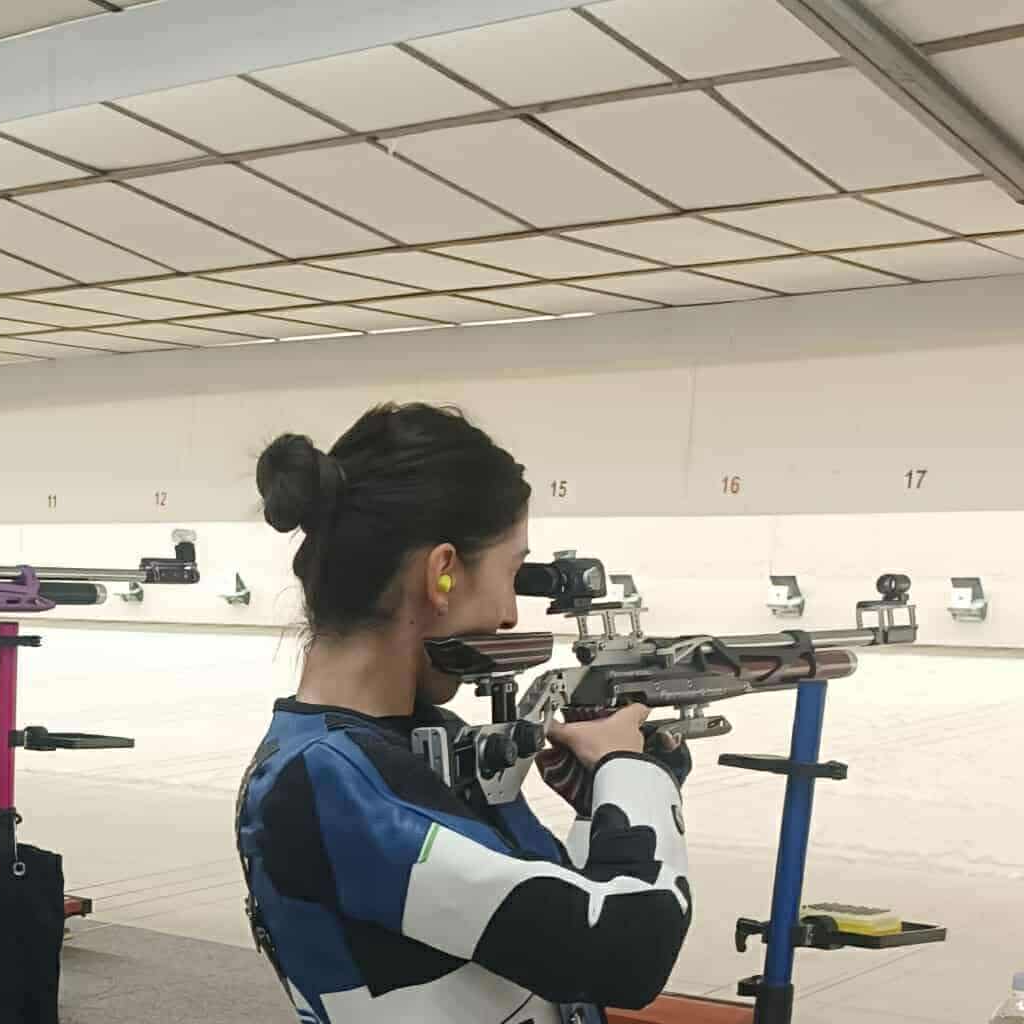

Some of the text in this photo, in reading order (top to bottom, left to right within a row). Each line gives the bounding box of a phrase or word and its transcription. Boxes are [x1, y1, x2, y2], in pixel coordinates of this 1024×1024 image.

[722, 475, 741, 495] 16
[904, 469, 927, 489] 17
[550, 480, 568, 498] 15
[47, 494, 57, 508] 11
[154, 491, 168, 507] 12
